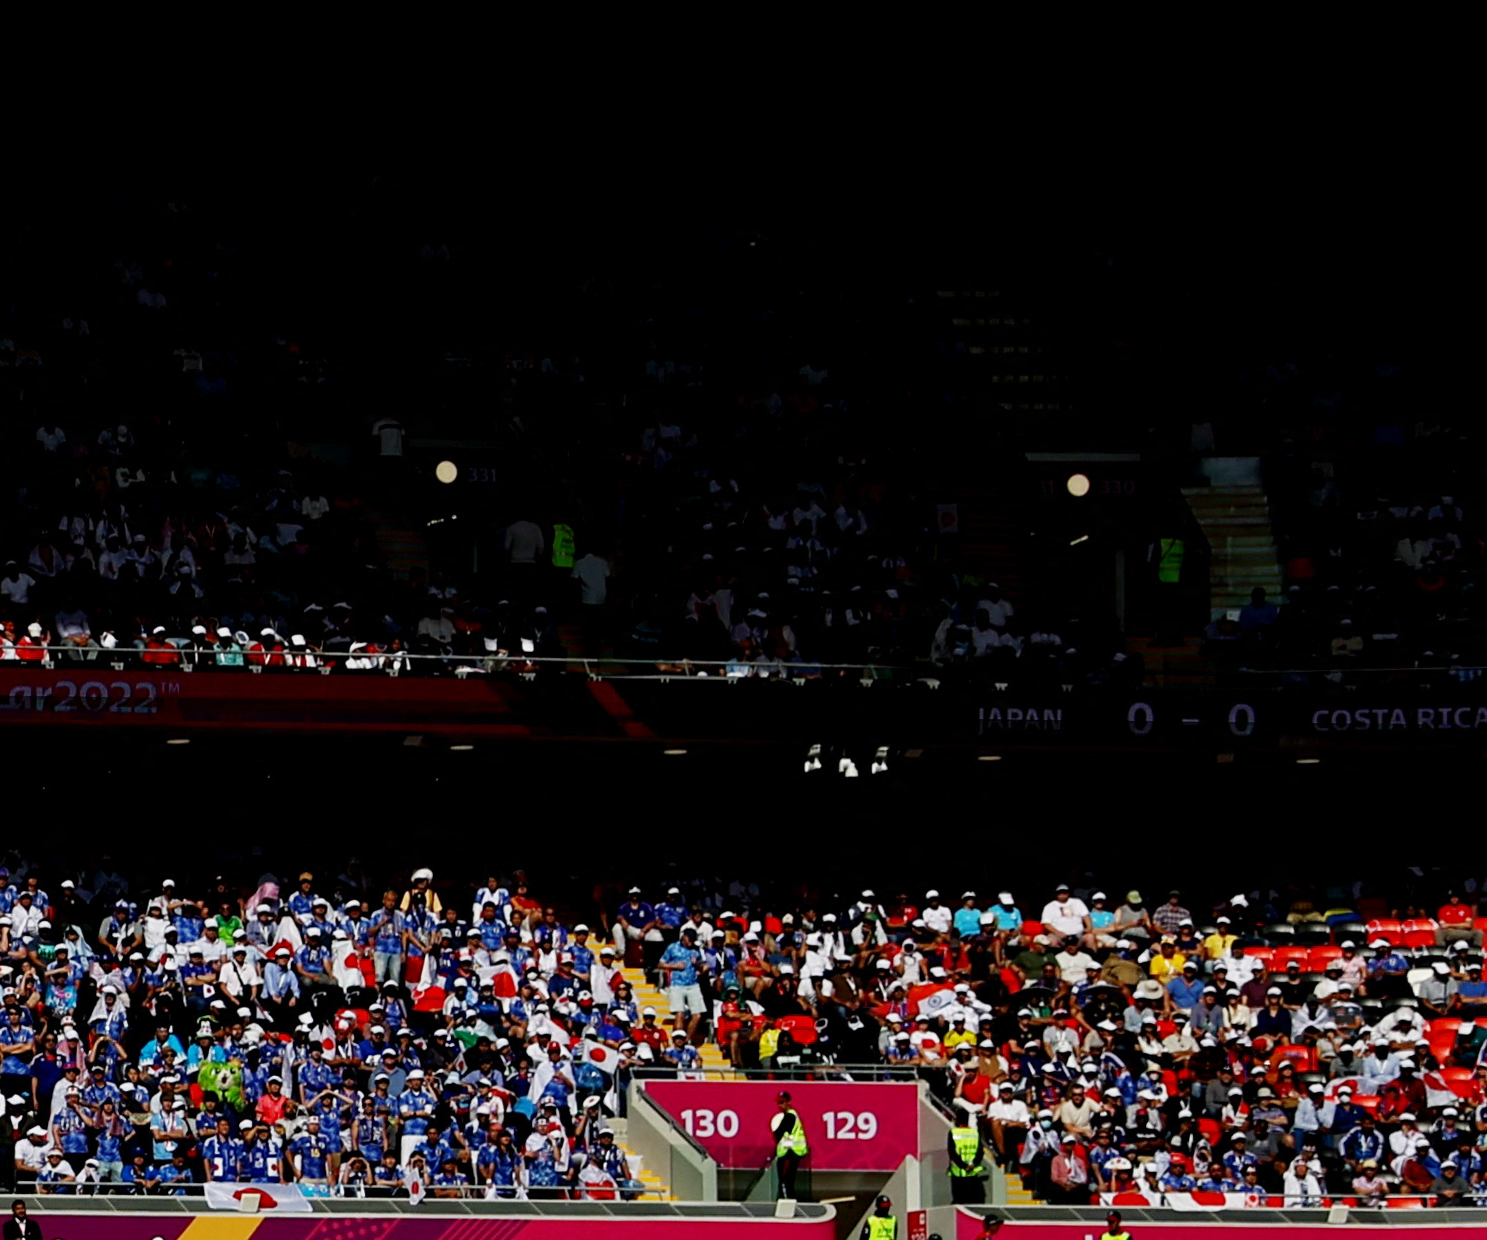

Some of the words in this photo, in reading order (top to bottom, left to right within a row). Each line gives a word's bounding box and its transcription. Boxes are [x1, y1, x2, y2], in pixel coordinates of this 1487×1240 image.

[978, 708, 1063, 735] JAPAN
[1311, 707, 1407, 732] COSTA
[680, 1109, 739, 1138] 130
[822, 1111, 877, 1140] 129
